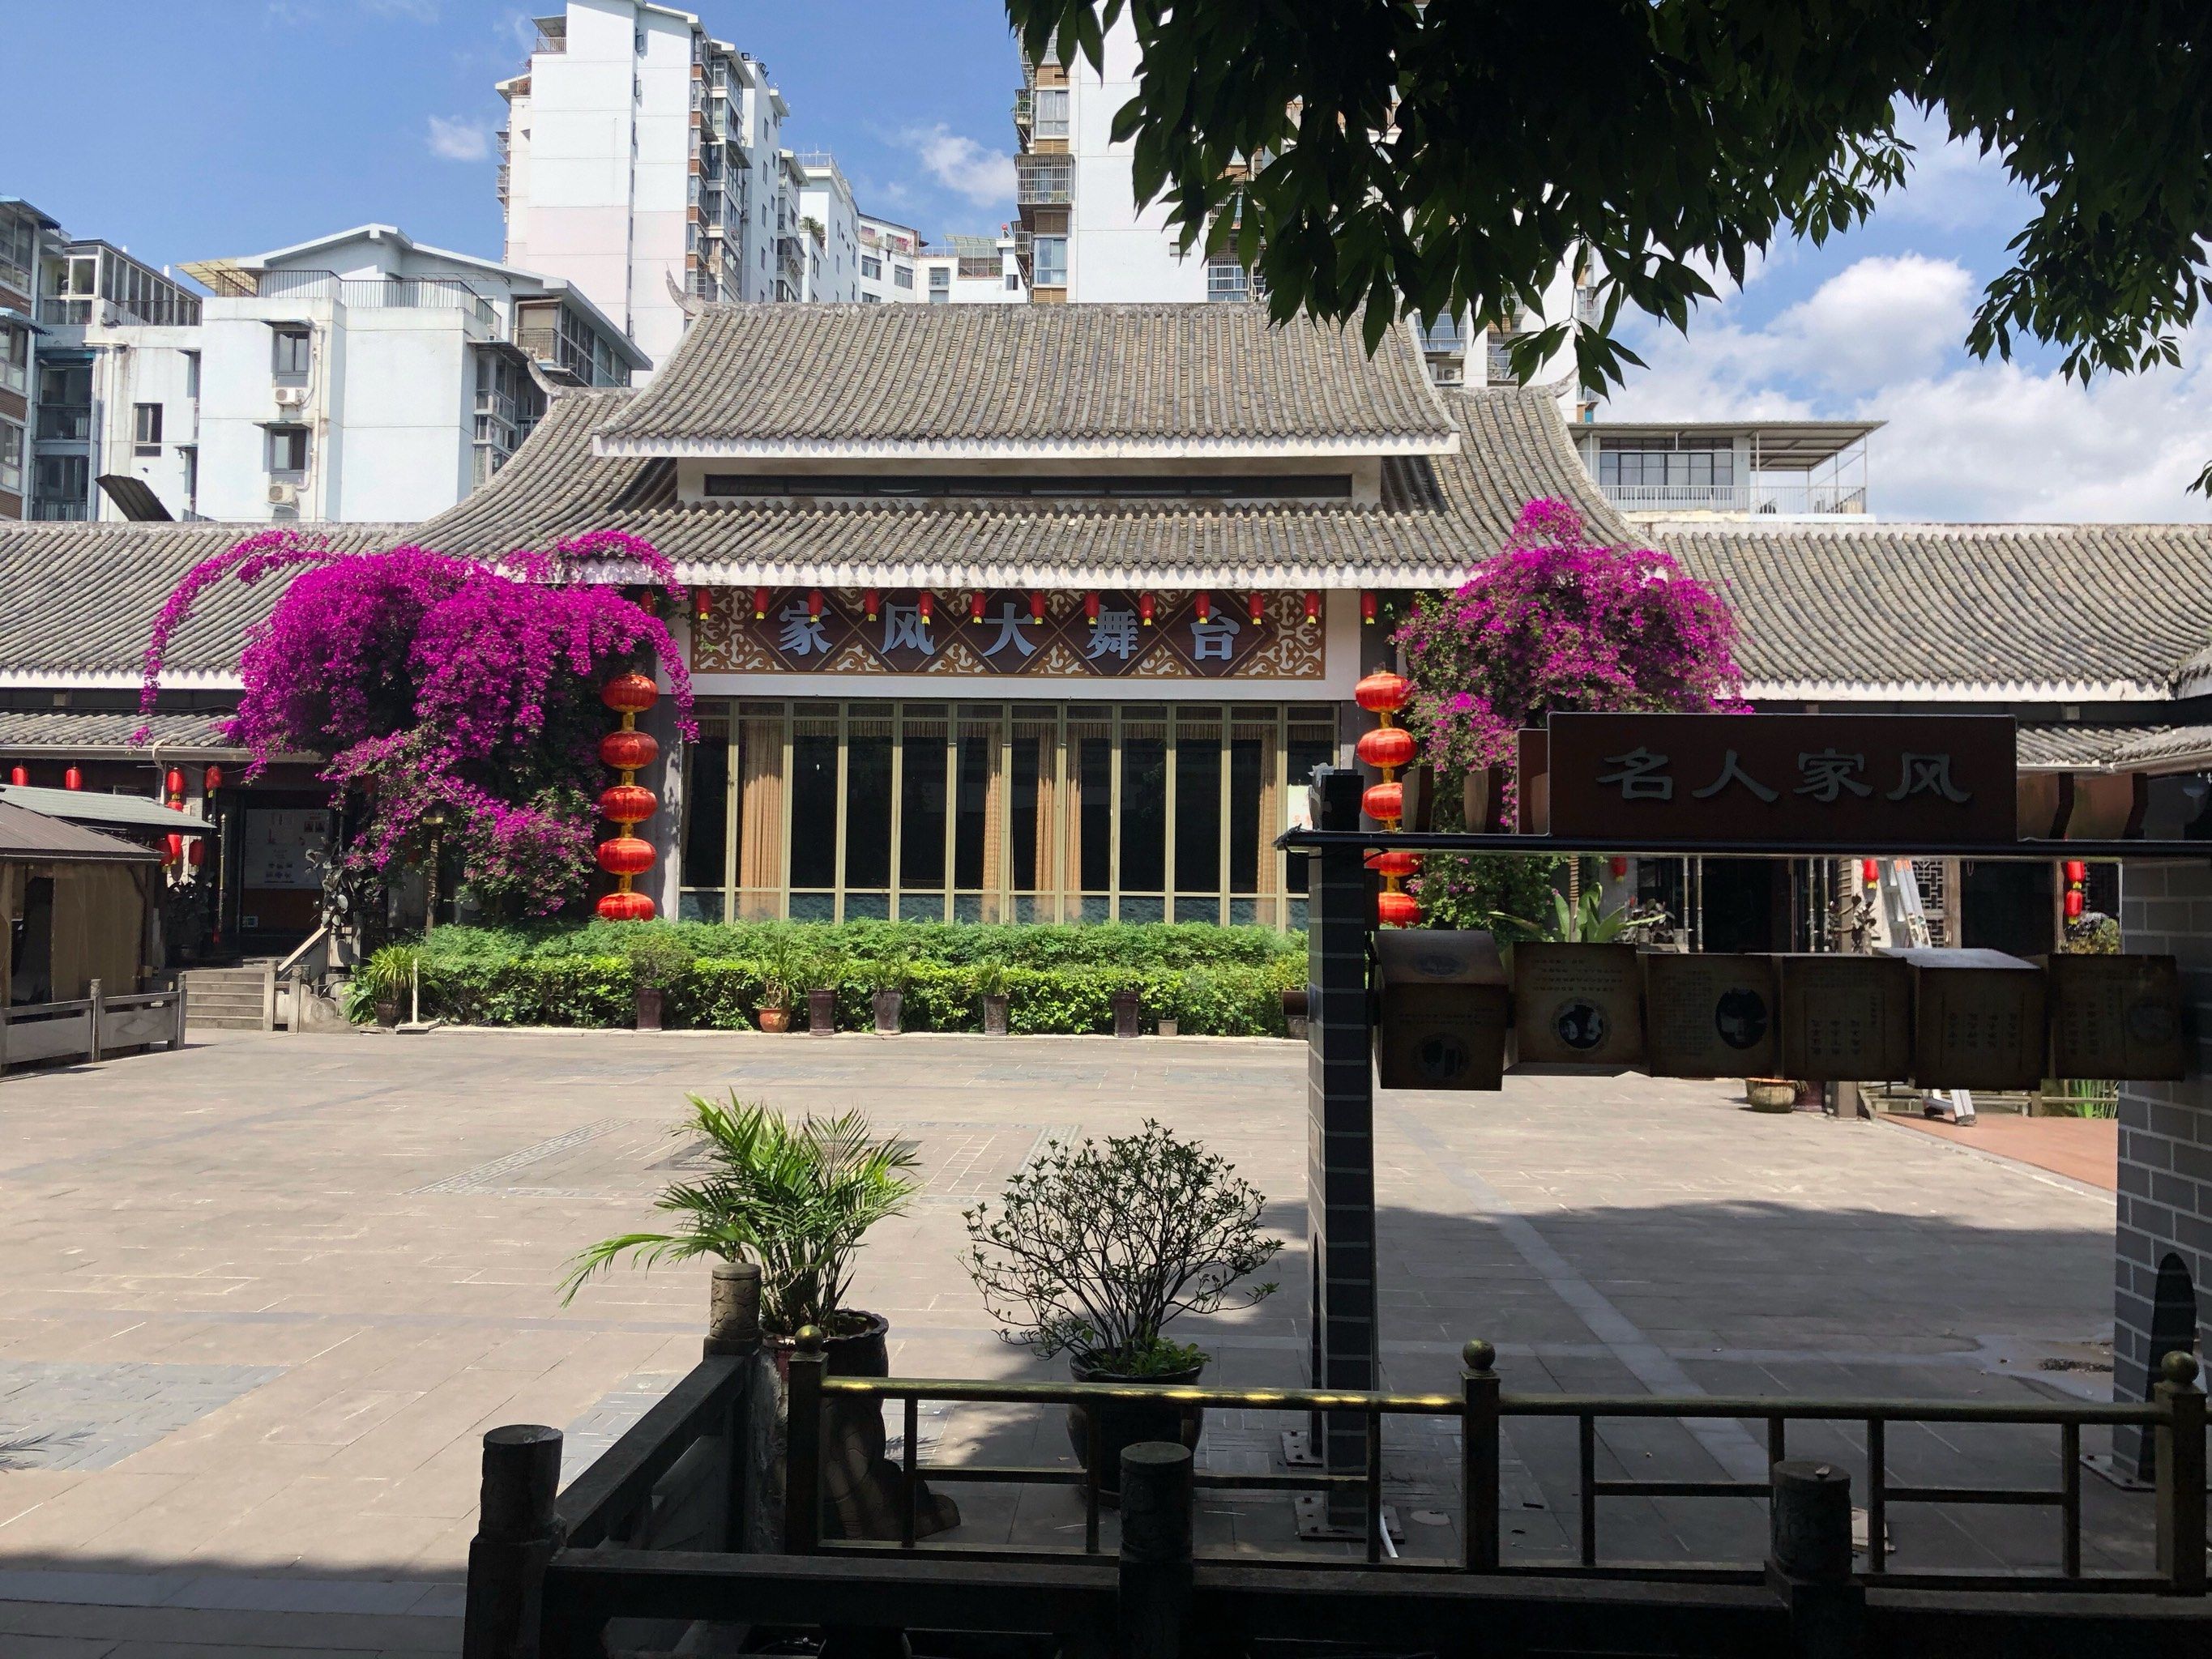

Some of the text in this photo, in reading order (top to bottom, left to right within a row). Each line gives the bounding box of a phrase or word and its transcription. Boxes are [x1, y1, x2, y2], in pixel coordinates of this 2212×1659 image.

[778, 600, 1241, 661] 家风大舞台
[1595, 746, 1973, 803] 名人家风
